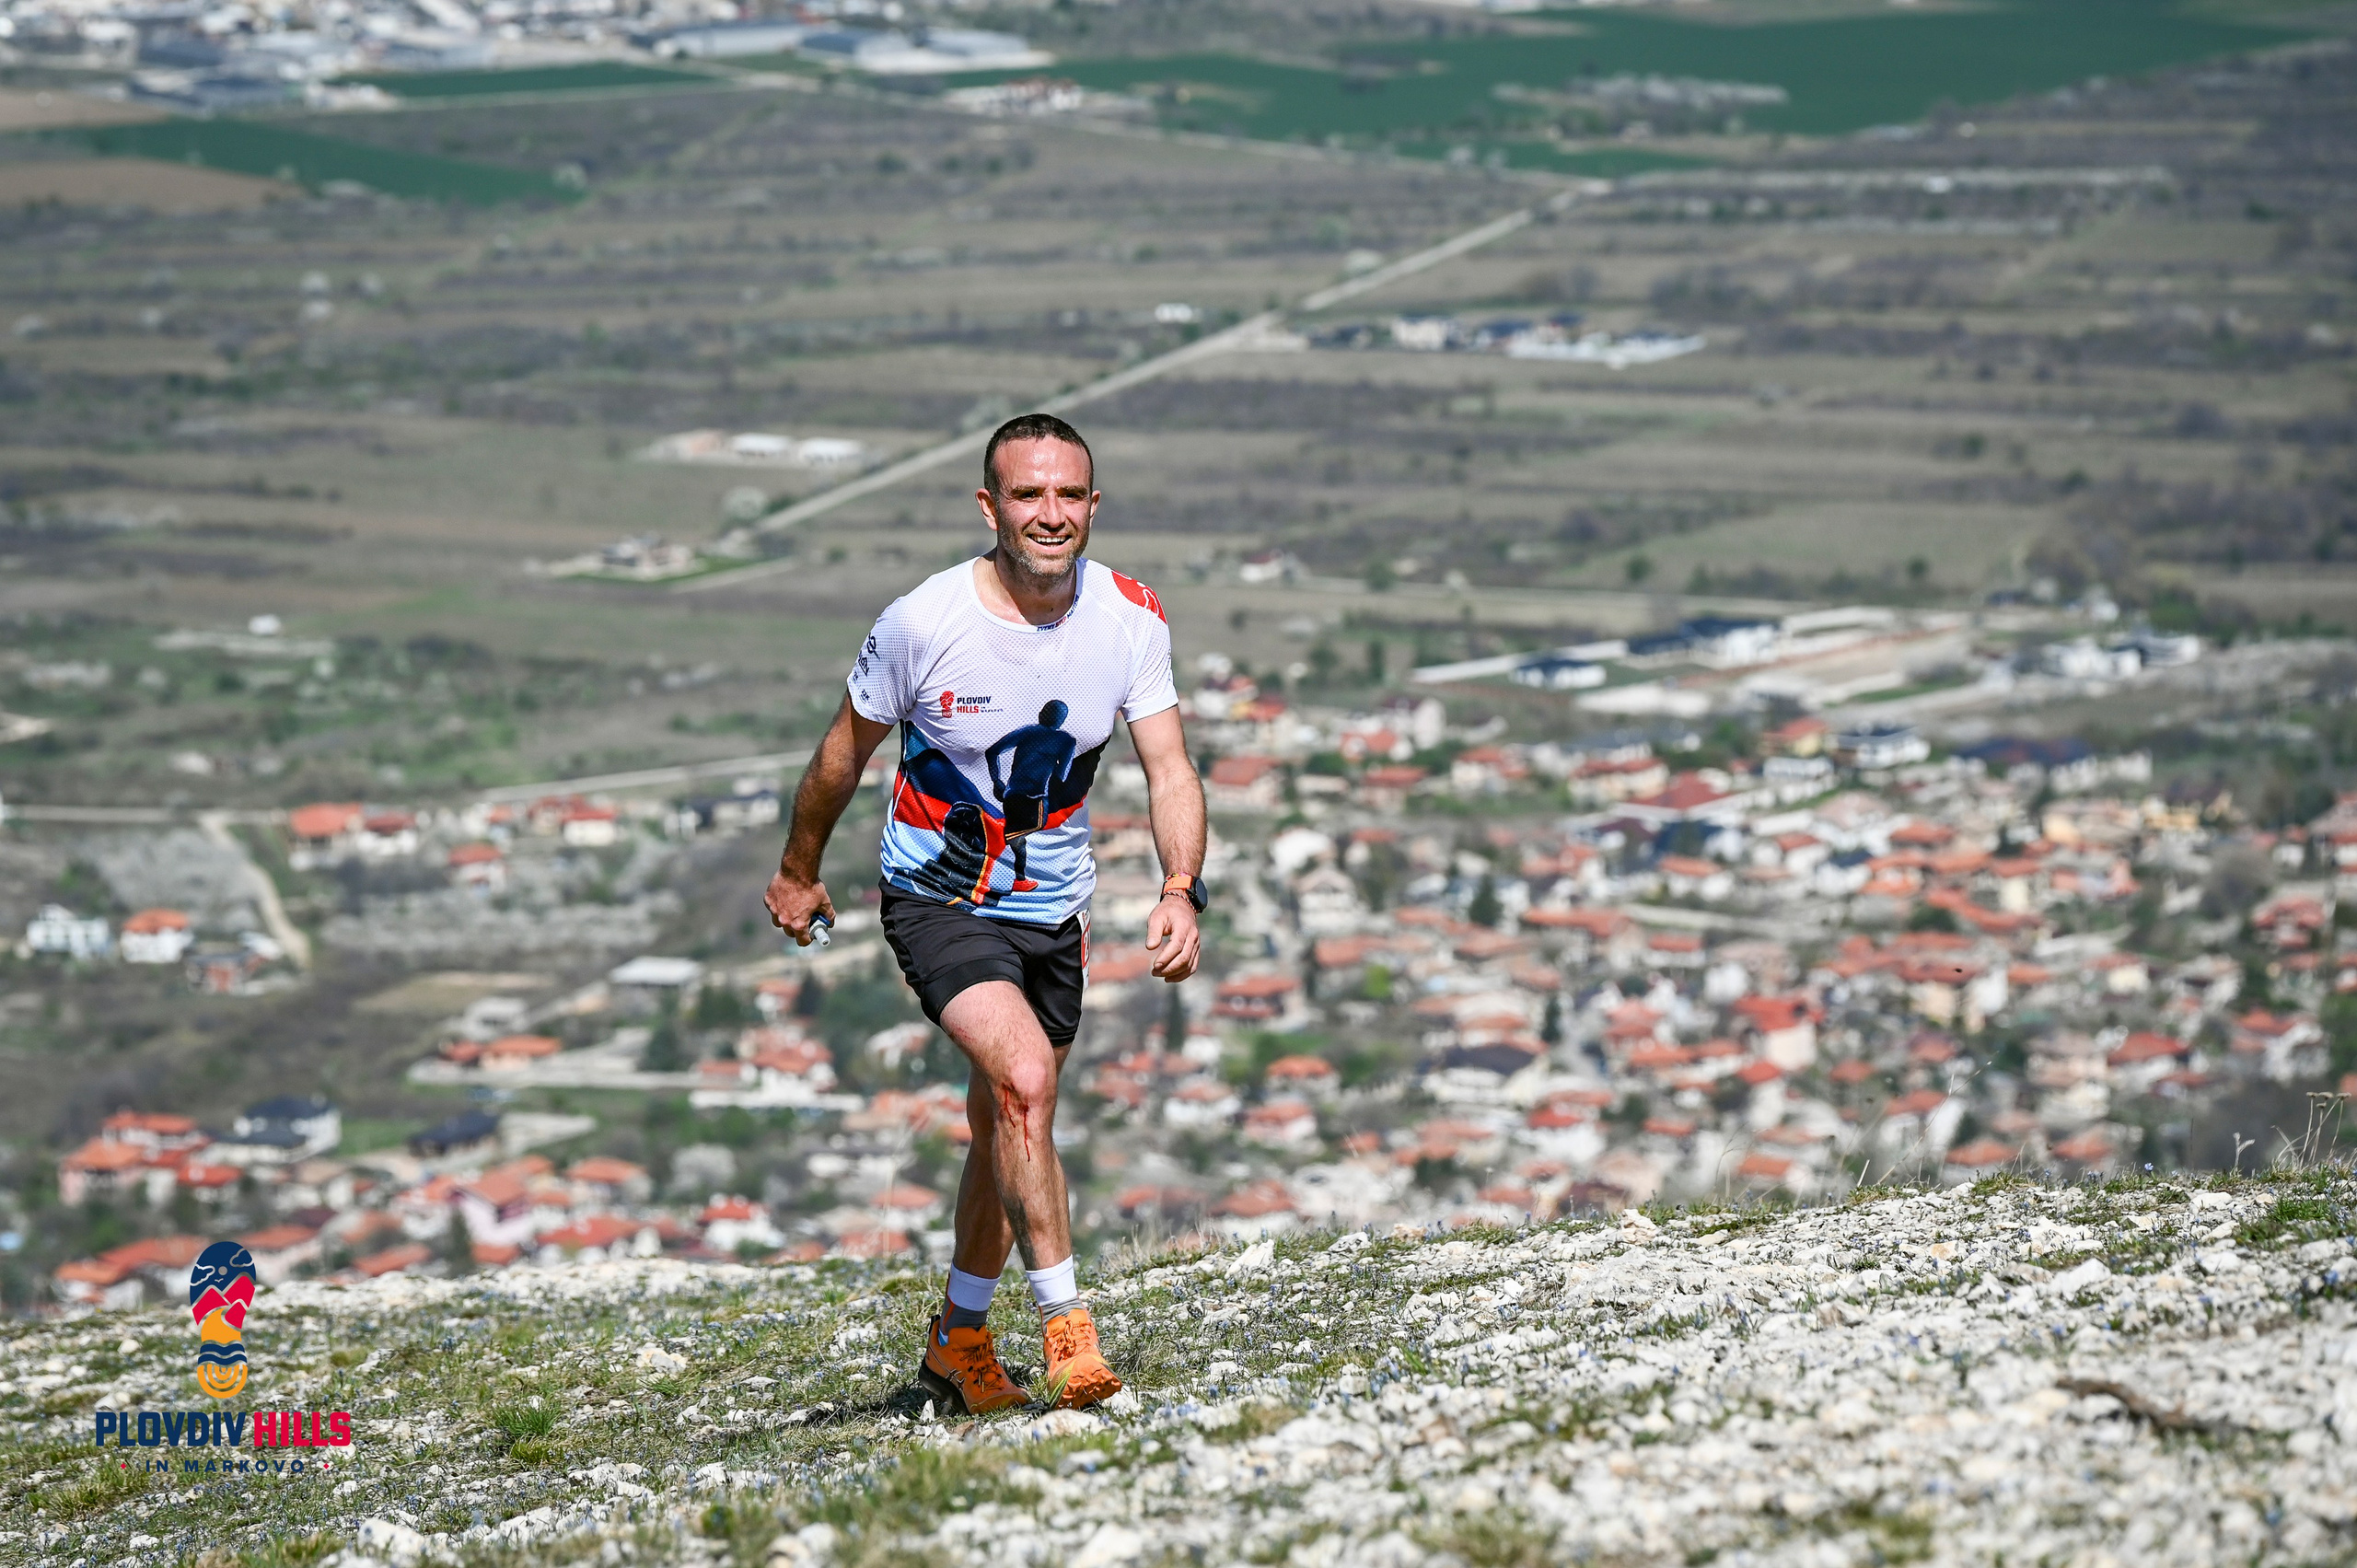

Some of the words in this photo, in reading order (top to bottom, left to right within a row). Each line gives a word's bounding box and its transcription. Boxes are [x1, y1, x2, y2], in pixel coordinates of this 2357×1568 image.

[1037, 623, 1056, 632] EVERY
[1055, 616, 1067, 628] STEP
[957, 696, 992, 704] PLOVDIV
[957, 705, 980, 714] HILLS
